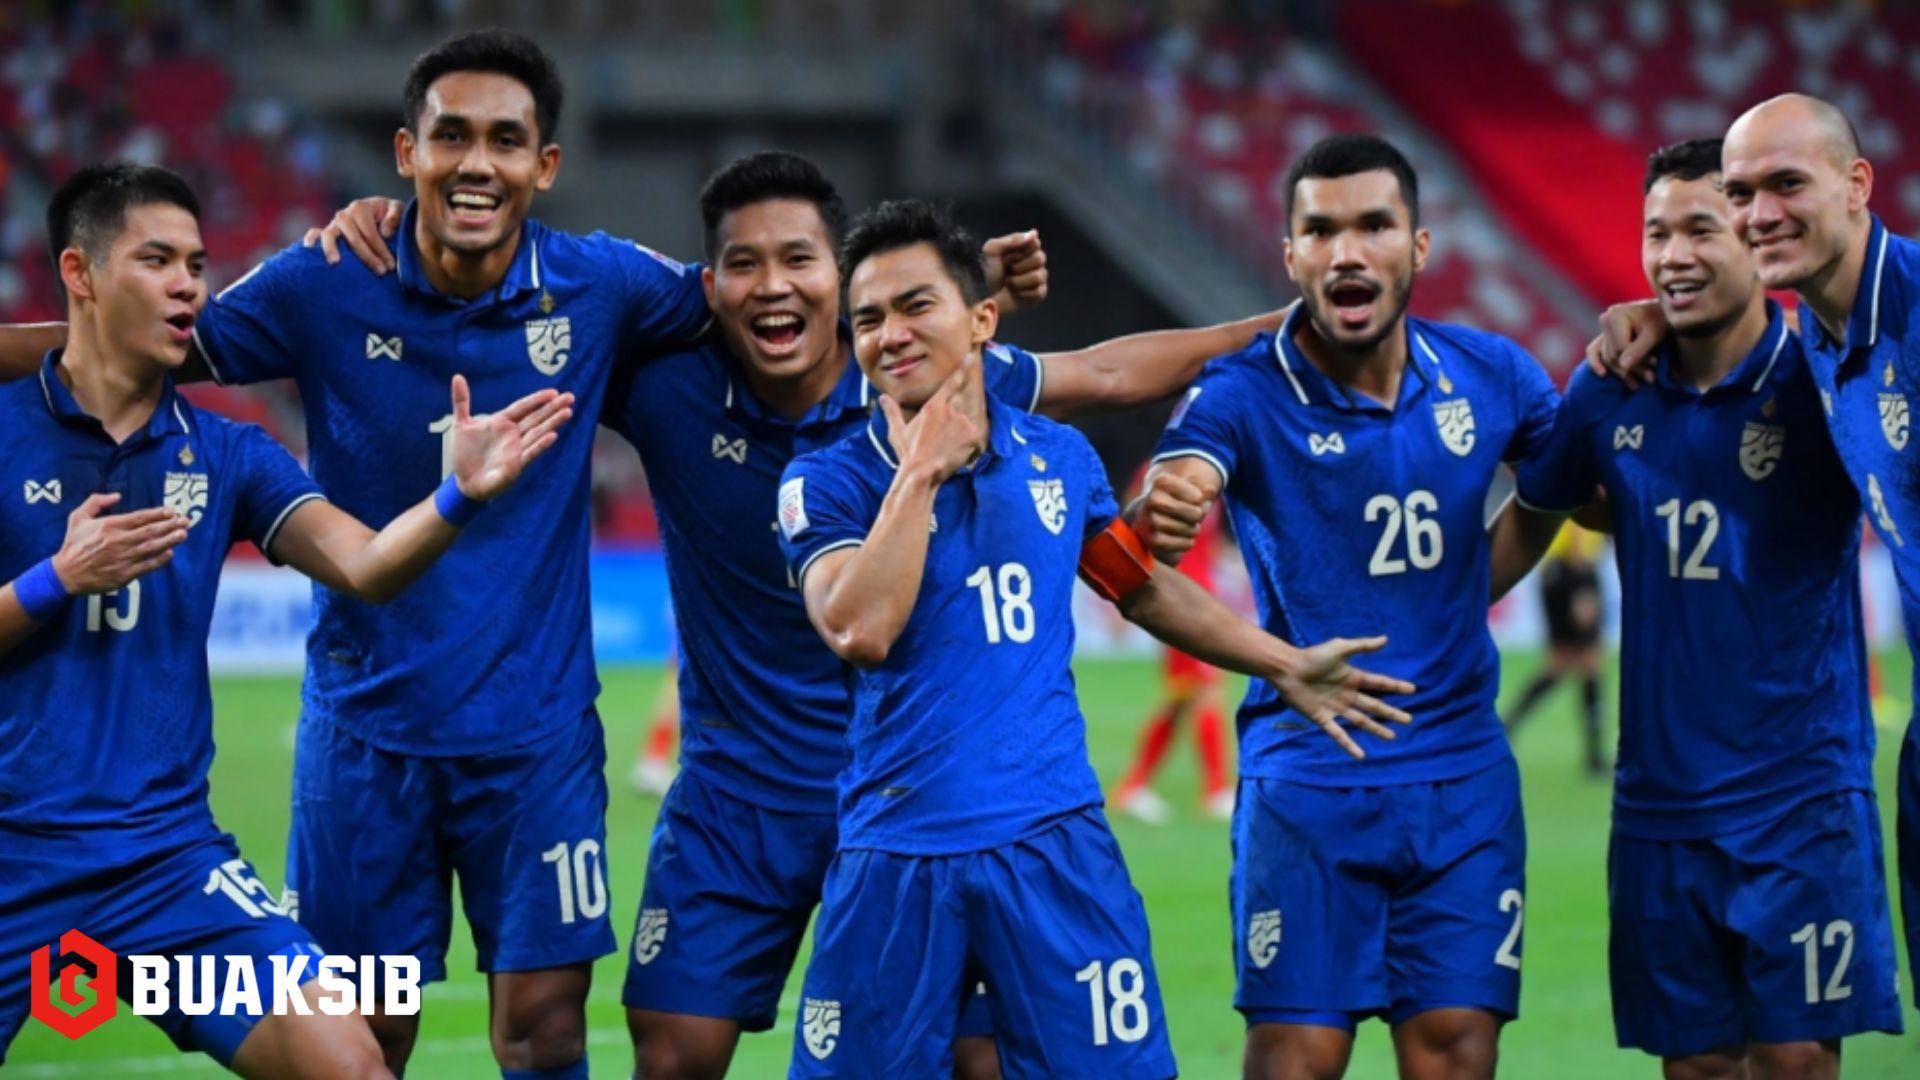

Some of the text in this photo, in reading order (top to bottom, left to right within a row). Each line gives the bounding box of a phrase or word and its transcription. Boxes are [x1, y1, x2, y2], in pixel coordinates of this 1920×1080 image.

[1364, 490, 1443, 576] 26
[1655, 498, 1720, 580] 12
[86, 578, 141, 632] 15
[966, 562, 1035, 643] 18
[203, 859, 289, 918] 15
[542, 838, 607, 924] 10
[1494, 888, 1523, 970] 2
[1790, 919, 1854, 1004] 12
[1075, 957, 1149, 1046] 18
